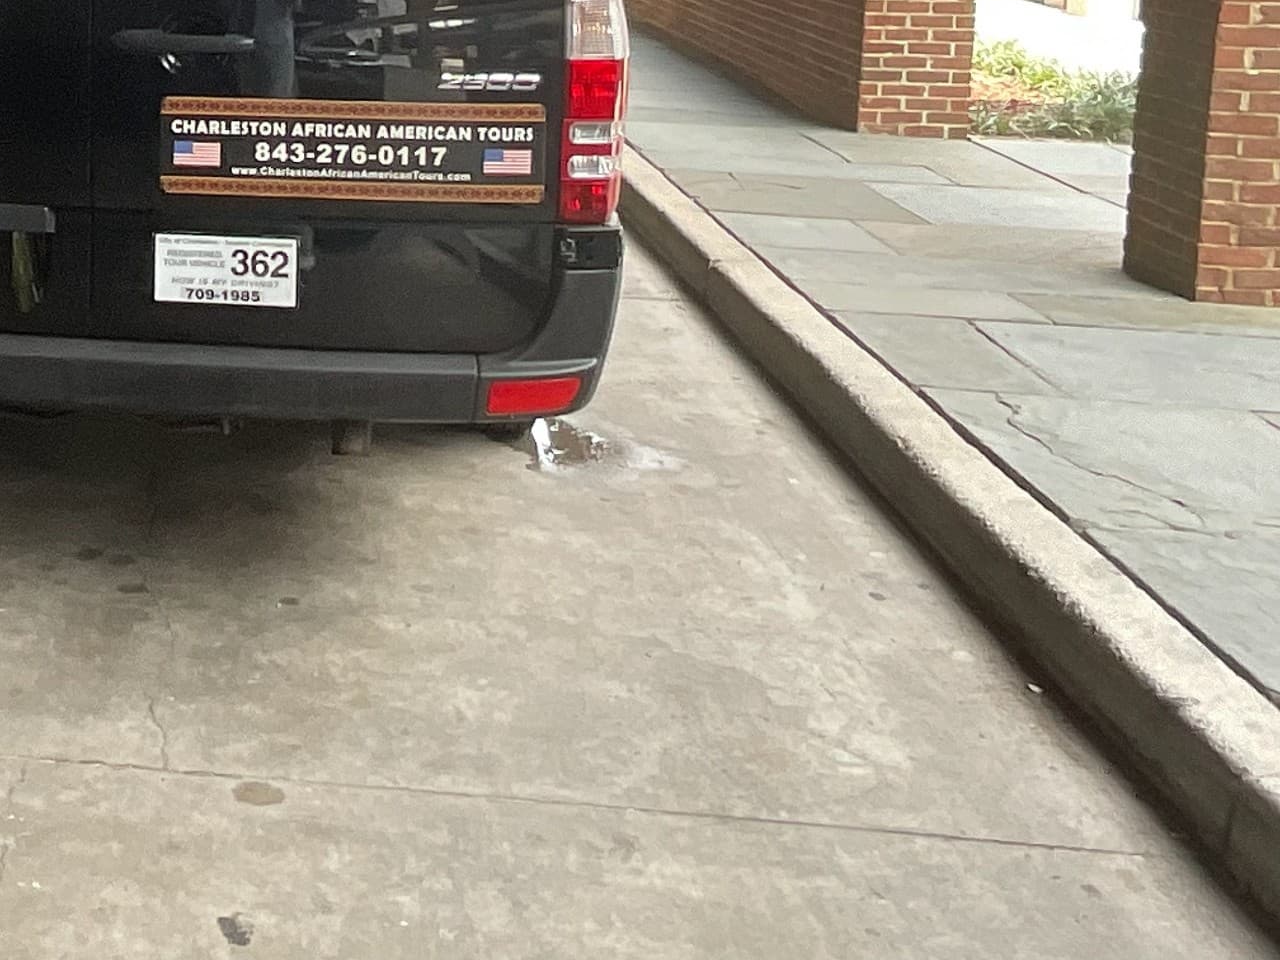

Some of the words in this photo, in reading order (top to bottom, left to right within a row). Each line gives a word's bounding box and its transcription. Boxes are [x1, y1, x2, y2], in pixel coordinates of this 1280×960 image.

[170, 119, 286, 137] CHARLESTON
[291, 122, 372, 139] AFRICAN
[377, 124, 472, 141] AMERICAN
[477, 126, 534, 142] TOURS
[254, 141, 448, 167] 843-276-0117
[231, 249, 289, 278] 362
[184, 288, 260, 302] 709-1985
